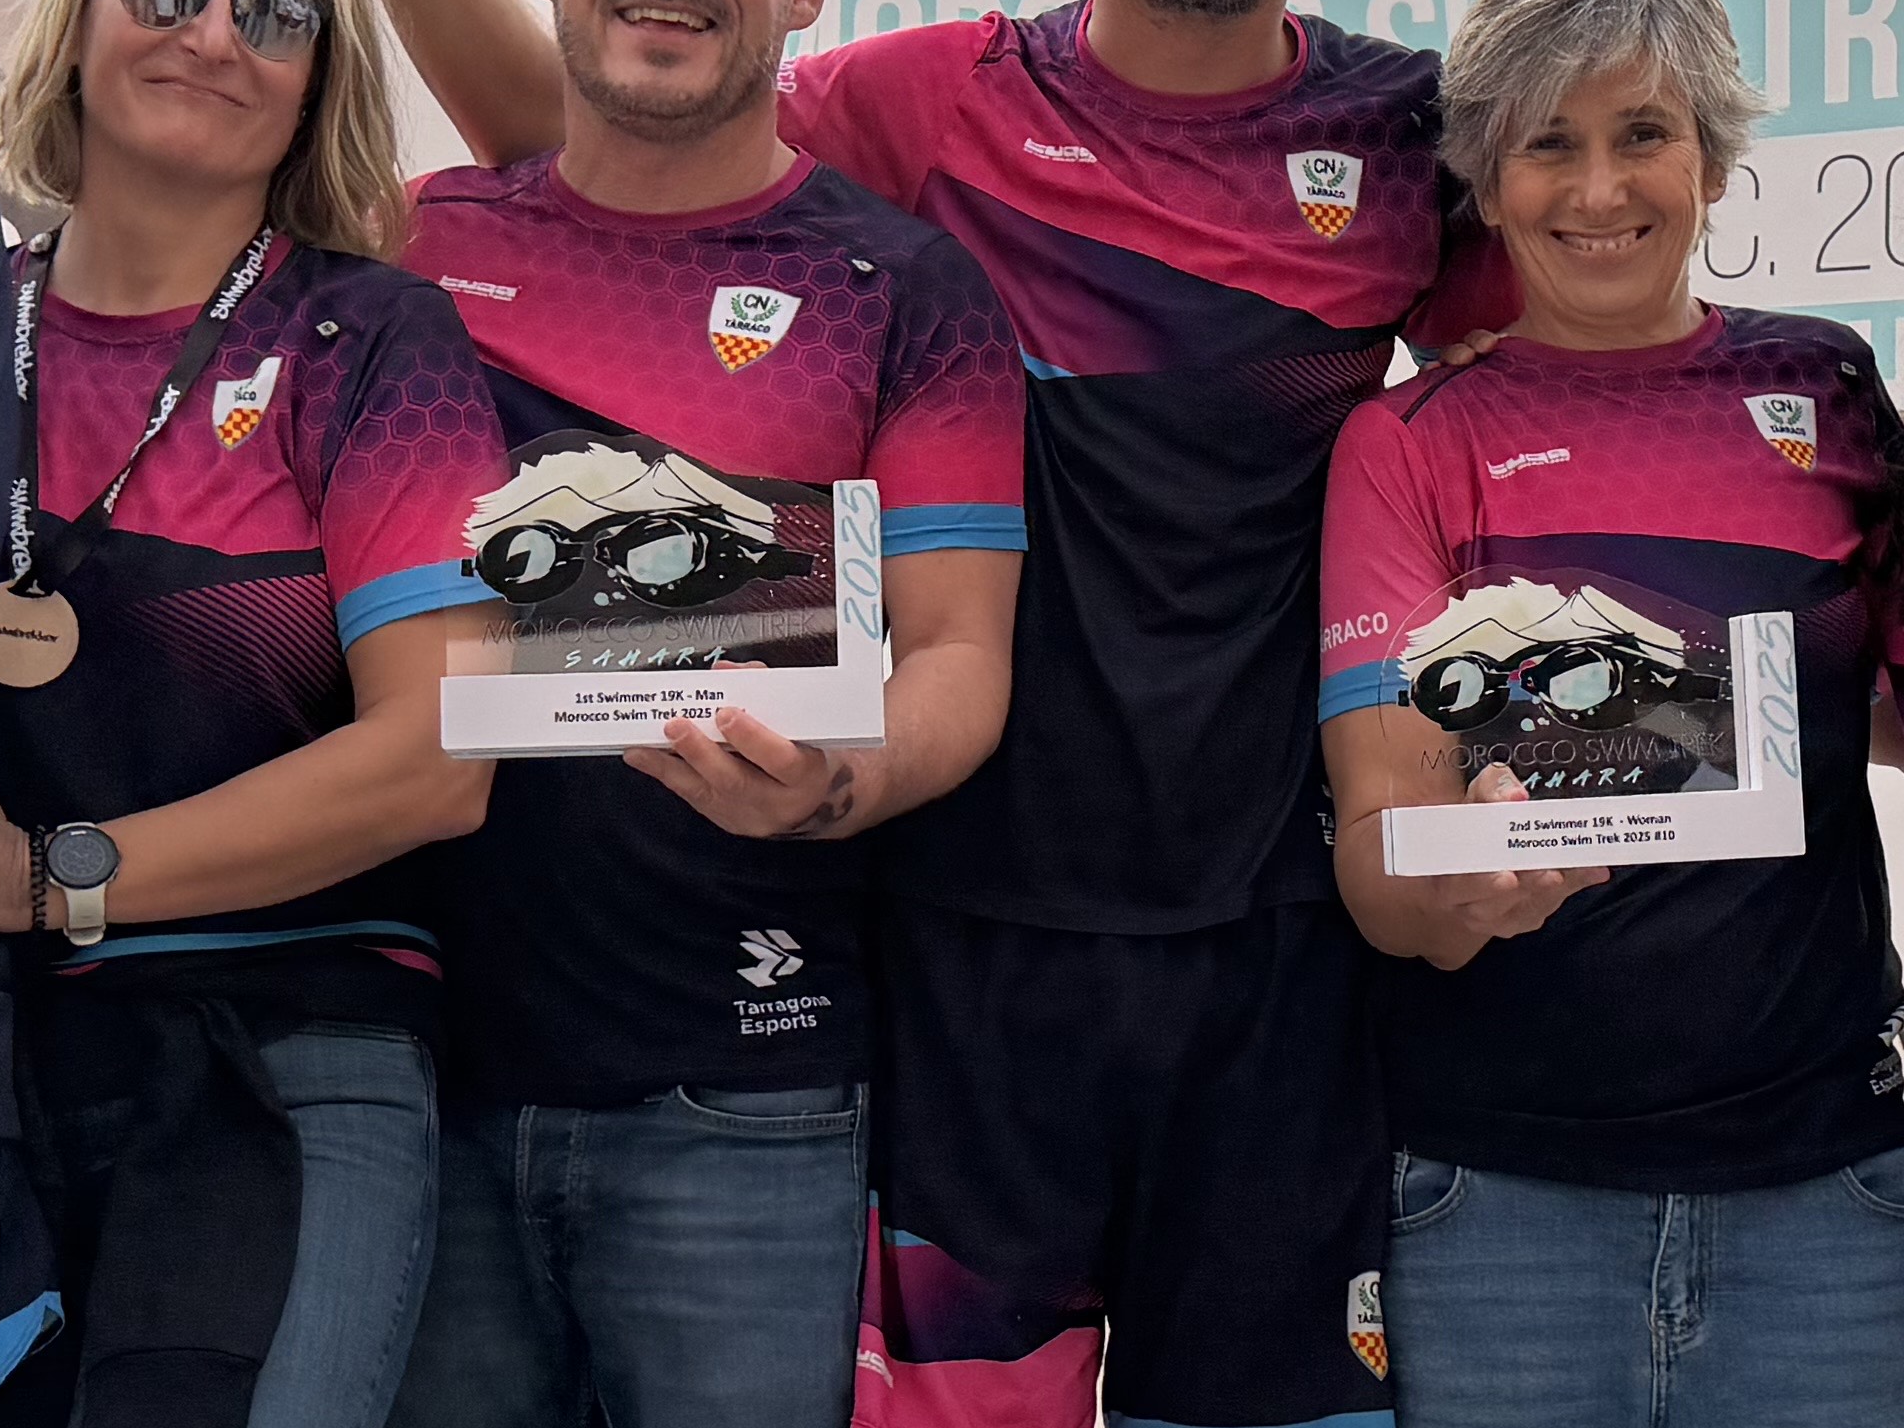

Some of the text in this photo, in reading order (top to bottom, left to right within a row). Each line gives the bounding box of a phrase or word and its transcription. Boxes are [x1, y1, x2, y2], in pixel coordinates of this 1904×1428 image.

[1314, 158, 1335, 174] CN
[744, 294, 770, 309] CN
[1771, 400, 1793, 413] CN
[838, 483, 884, 641] 2025
[482, 610, 817, 646] MOROCCO SWIM TREK
[1321, 611, 1389, 653] RRACO
[563, 645, 727, 669] SAHARA
[575, 692, 594, 704] 1st
[597, 691, 656, 703] Swimmer
[661, 689, 684, 701] 19K
[696, 689, 724, 701] Man
[1753, 617, 1798, 780] 2025
[554, 710, 609, 723] Morocco
[613, 707, 647, 720] Swim
[650, 706, 678, 720] Trek
[681, 707, 712, 719] 2025
[1420, 738, 1581, 770] MOROCCO
[1585, 735, 1660, 764] SWIM
[1496, 768, 1644, 792] SAHARA
[1509, 821, 1531, 832] 2nd
[1534, 820, 1588, 831] Swimmer
[1592, 816, 1614, 827] 19K
[1627, 814, 1672, 825] Woman
[1507, 837, 1558, 849] Morocco
[1561, 834, 1592, 846] Swim
[1595, 832, 1621, 844] Trek
[1624, 831, 1651, 843] 2025
[733, 992, 832, 1017] Tarragona
[740, 1012, 817, 1036] Esports
